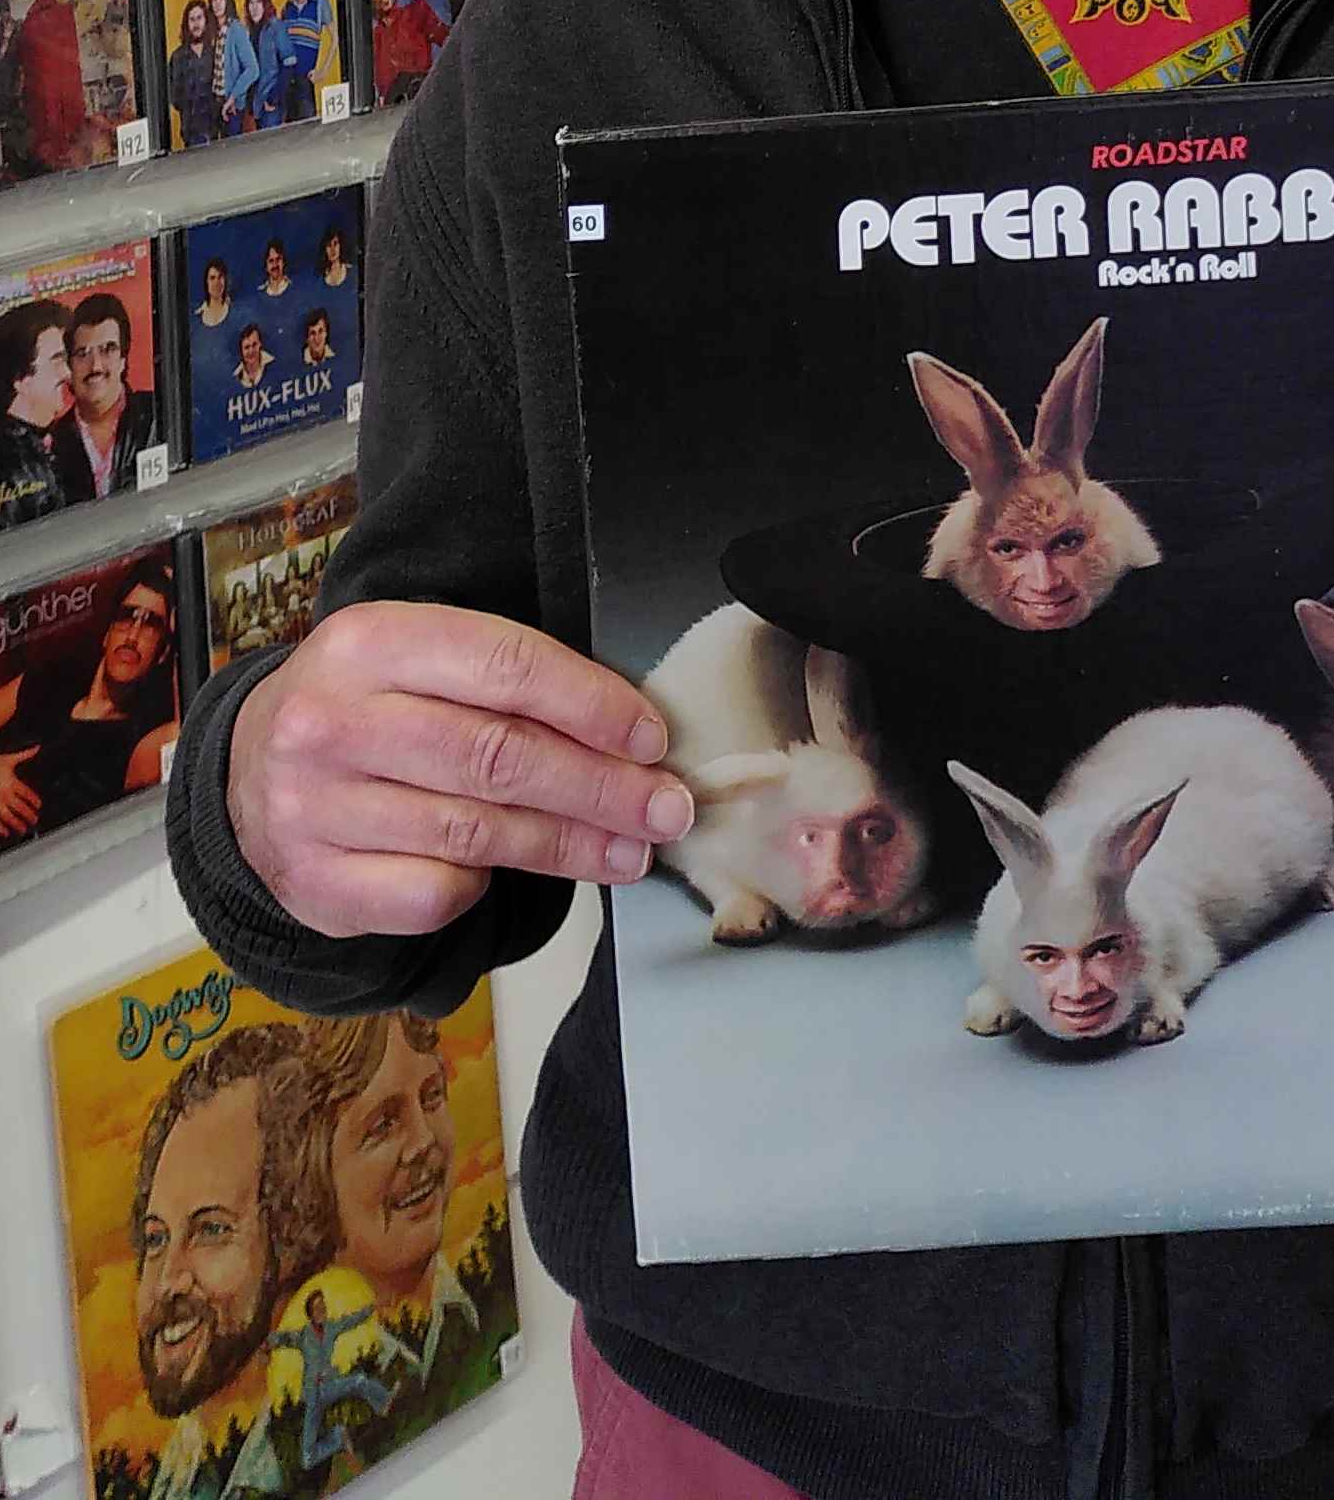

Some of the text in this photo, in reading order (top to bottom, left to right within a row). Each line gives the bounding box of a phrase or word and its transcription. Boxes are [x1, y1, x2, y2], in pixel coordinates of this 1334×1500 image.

[121, 134, 145, 157] 192
[1092, 136, 1247, 169] ROADSTAR
[573, 216, 597, 232] 60
[838, 185, 1090, 271] PETER
[1099, 251, 1256, 287] Rock'n Roll
[228, 369, 331, 422] HUX-FLUX
